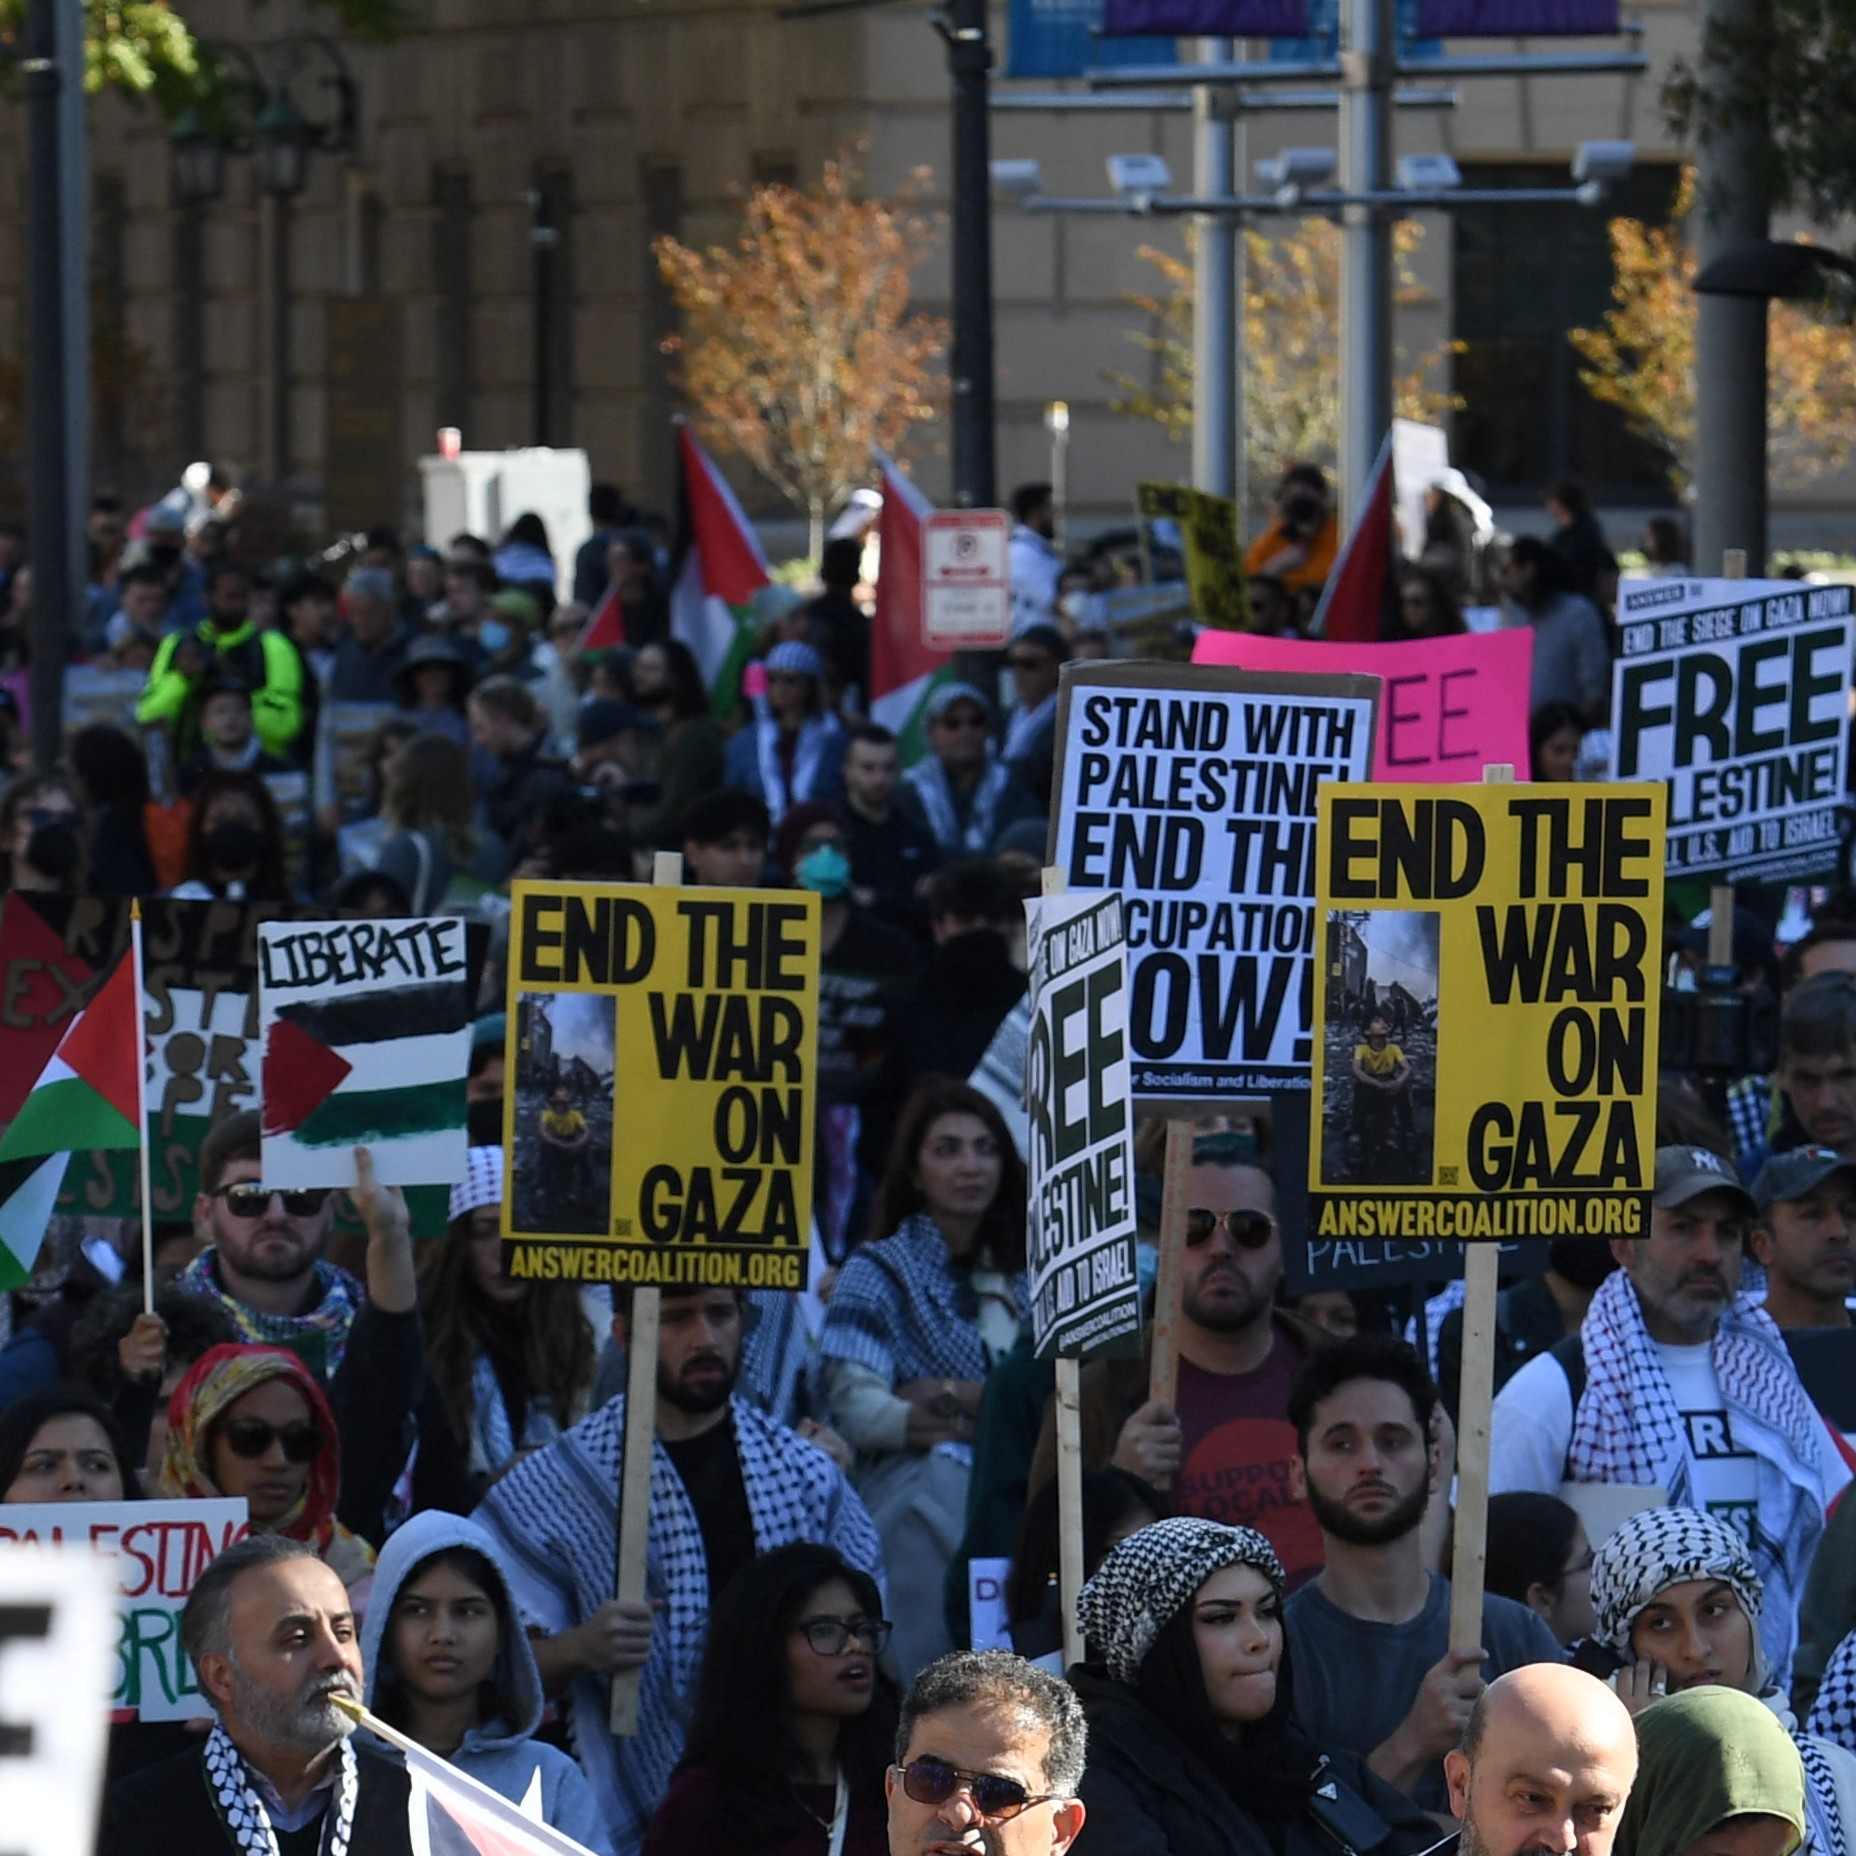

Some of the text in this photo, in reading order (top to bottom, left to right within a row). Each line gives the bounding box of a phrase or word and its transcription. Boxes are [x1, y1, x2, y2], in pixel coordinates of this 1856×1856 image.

[1623, 624, 1654, 653] END
[1660, 617, 1687, 649] THE
[1693, 608, 1737, 641] SIEGE
[1766, 595, 1804, 627] GAZA
[1081, 696, 1355, 758] STAND WITH
[1386, 668, 1478, 767] EE
[1618, 626, 1845, 778] FREE
[1666, 743, 1839, 826] LESTINE!
[1068, 812, 1204, 890] END
[1329, 798, 1651, 899] END THE
[1785, 807, 1836, 847] ISRAEL
[259, 920, 466, 988] LIBERATE
[521, 894, 808, 990] END THE
[1124, 899, 1315, 953] CUPATIO
[1476, 903, 1646, 1004] WAR
[648, 991, 804, 1083] WAR
[1130, 953, 1315, 1061] OW!
[1029, 957, 1126, 1182] REE
[1142, 1071, 1213, 1087] Socialism
[1216, 1074, 1244, 1088] and
[1547, 1007, 1645, 1097] ON
[714, 1086, 802, 1165] ON
[1467, 1101, 1642, 1192] GAZA
[639, 1164, 800, 1246] GAZA
[1318, 1197, 1641, 1237] ANSWERCOALITION.ORG
[510, 1245, 800, 1287] ANSWERCOALITION.ORG
